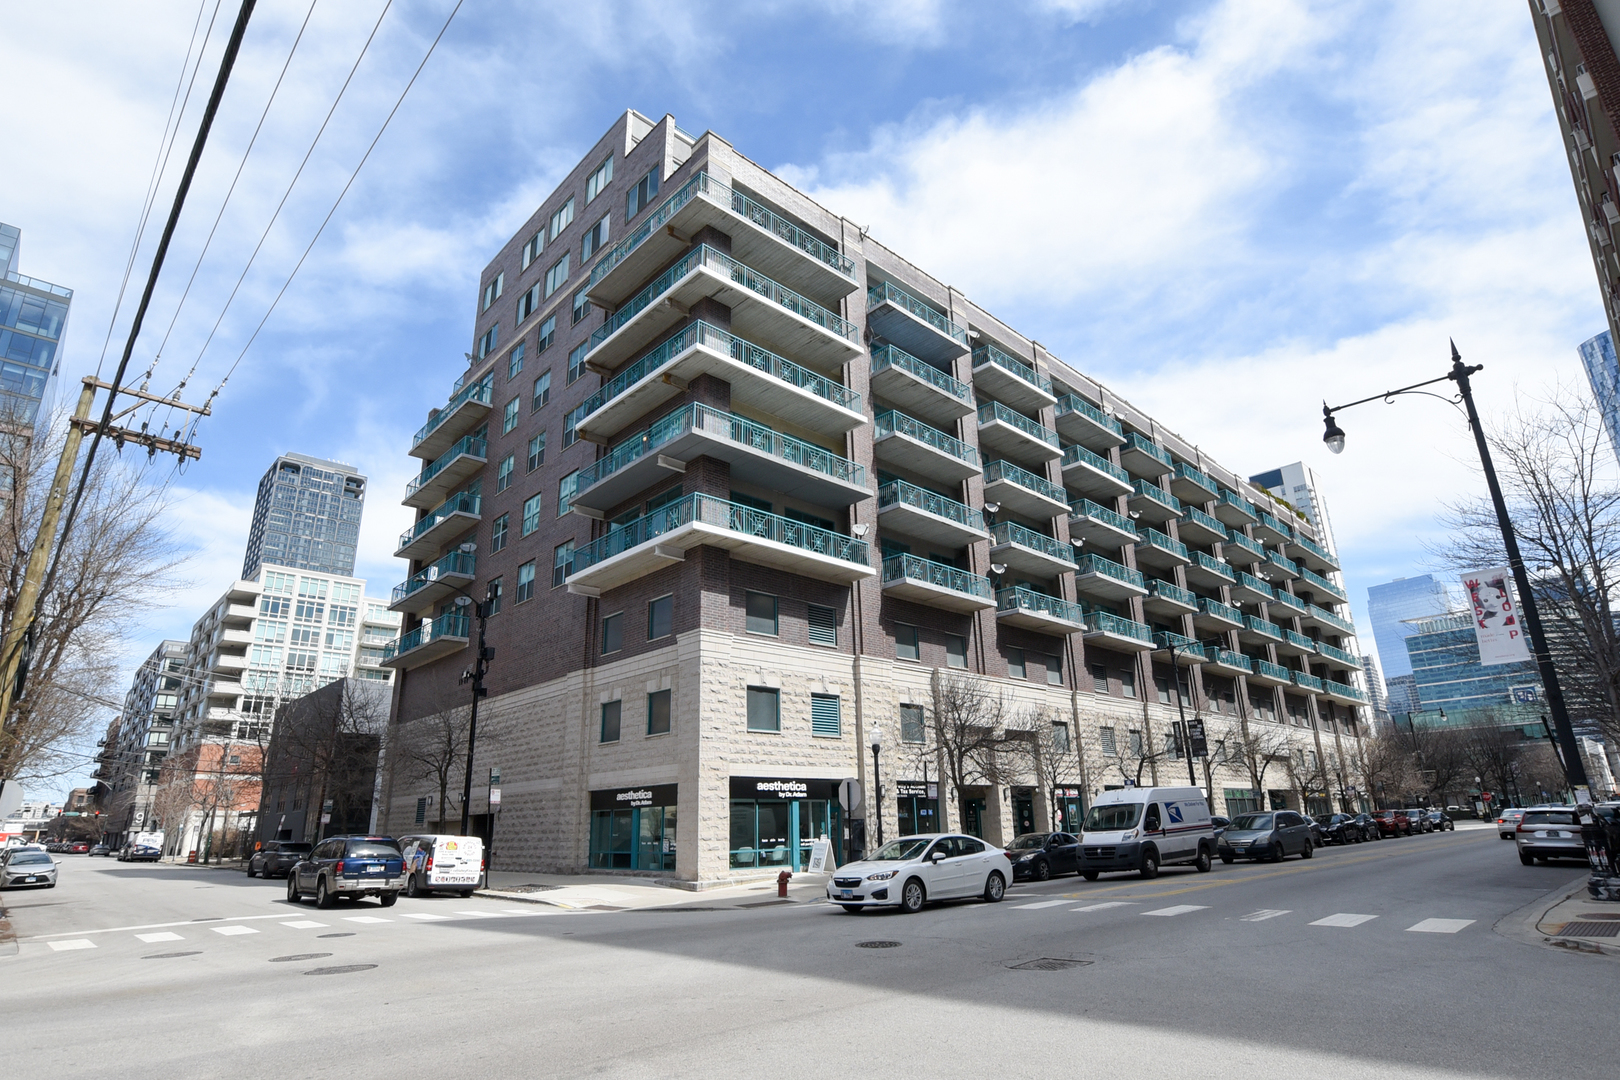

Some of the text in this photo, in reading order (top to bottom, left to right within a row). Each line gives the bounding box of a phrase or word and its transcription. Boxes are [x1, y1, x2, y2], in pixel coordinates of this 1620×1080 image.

[1499, 588, 1518, 639] LOOP
[756, 781, 807, 791] aesthetica
[616, 790, 652, 800] aesthetica
[135, 812, 144, 823] 9
